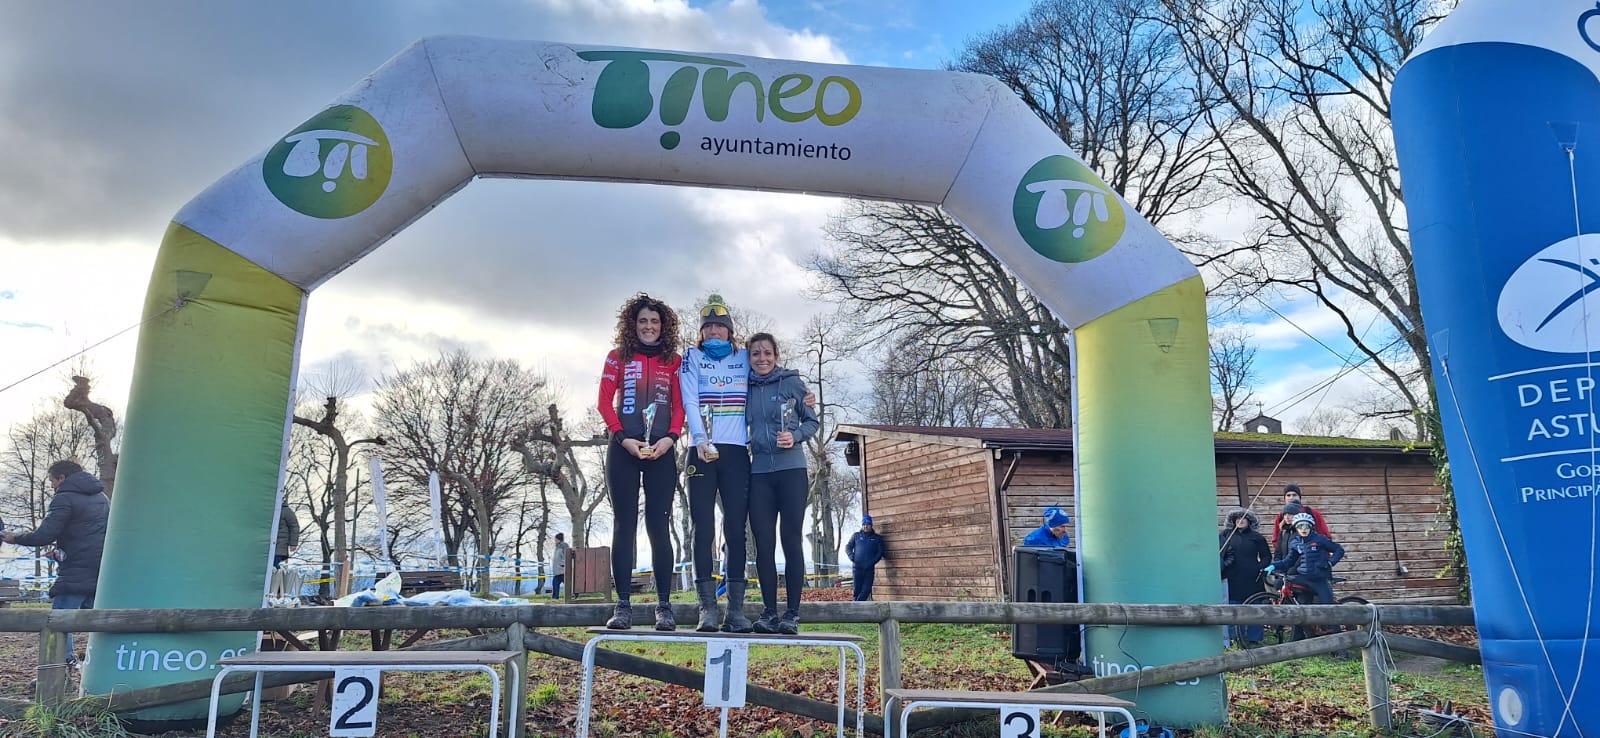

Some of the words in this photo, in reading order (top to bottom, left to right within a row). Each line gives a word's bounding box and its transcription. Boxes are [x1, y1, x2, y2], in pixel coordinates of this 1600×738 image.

[700, 136, 852, 161] ayuntamiento
[710, 649, 732, 701] 1
[335, 676, 374, 729] 2
[1004, 712, 1035, 738] 3
